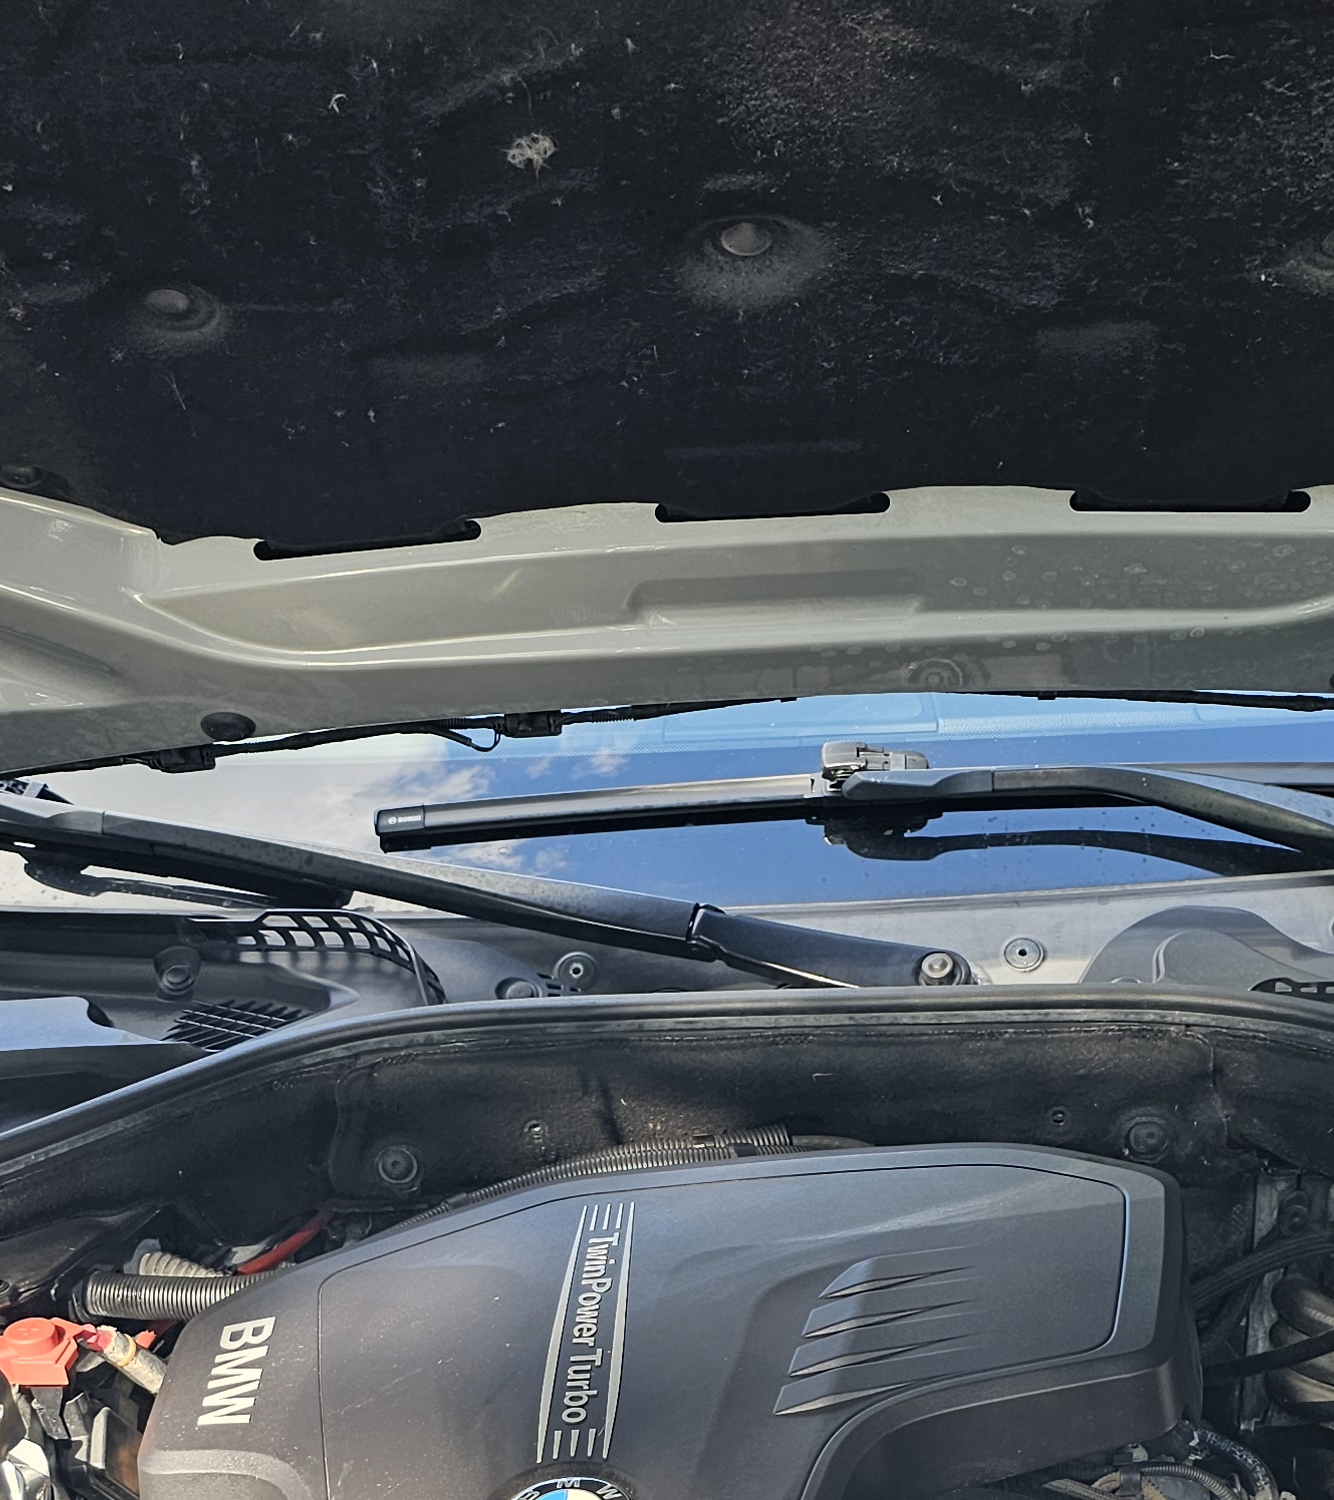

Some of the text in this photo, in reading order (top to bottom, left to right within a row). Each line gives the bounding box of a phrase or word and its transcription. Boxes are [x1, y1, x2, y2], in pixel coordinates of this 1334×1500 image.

[197, 1316, 276, 1427] BMW
[561, 1231, 620, 1425] TwinPower Turbo
